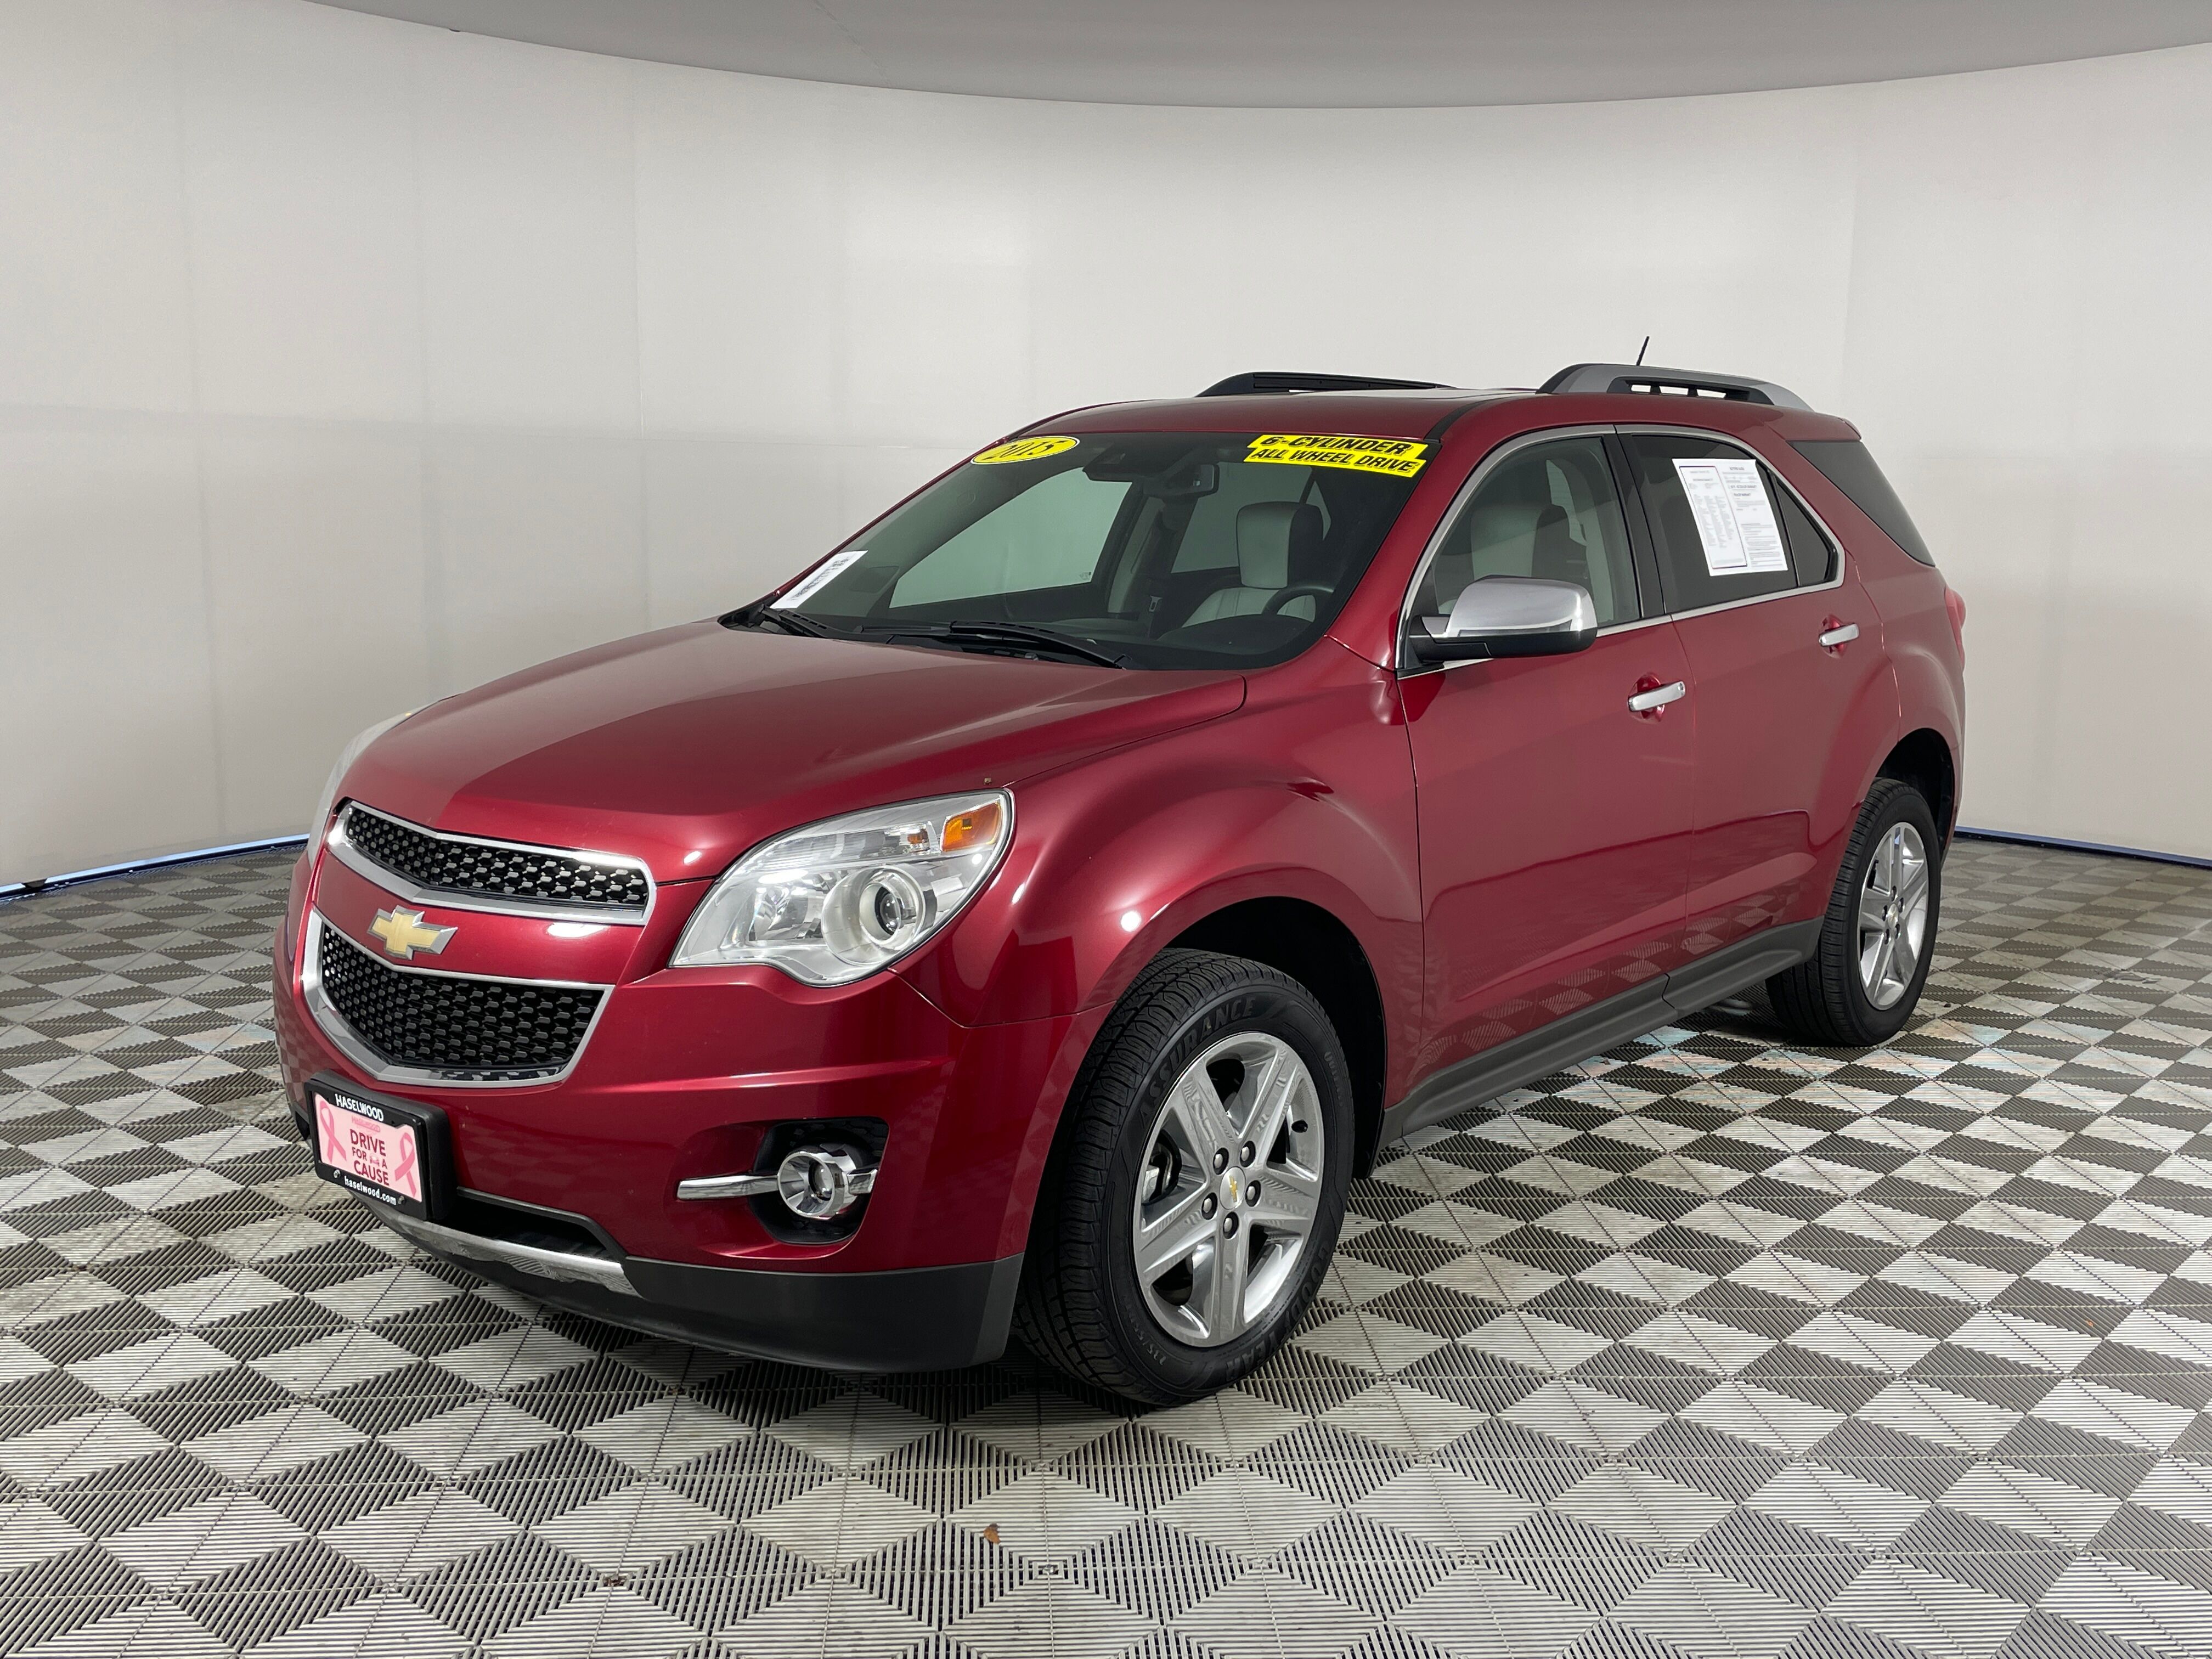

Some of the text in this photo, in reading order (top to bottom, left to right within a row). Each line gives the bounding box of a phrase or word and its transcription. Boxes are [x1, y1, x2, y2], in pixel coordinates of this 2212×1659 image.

[981, 439, 1067, 461] 2015
[1260, 435, 1414, 455] 6-CYLINDER
[1251, 448, 1419, 472] ALL WHEEL DRIVE
[1139, 997, 1256, 1128] ASSURANCE
[335, 1093, 384, 1122] HASELWOOD
[349, 1128, 386, 1156] DRIVE
[351, 1147, 388, 1169] FOR A
[353, 1161, 390, 1186] CAUSE
[344, 1175, 397, 1206] haselwood.com
